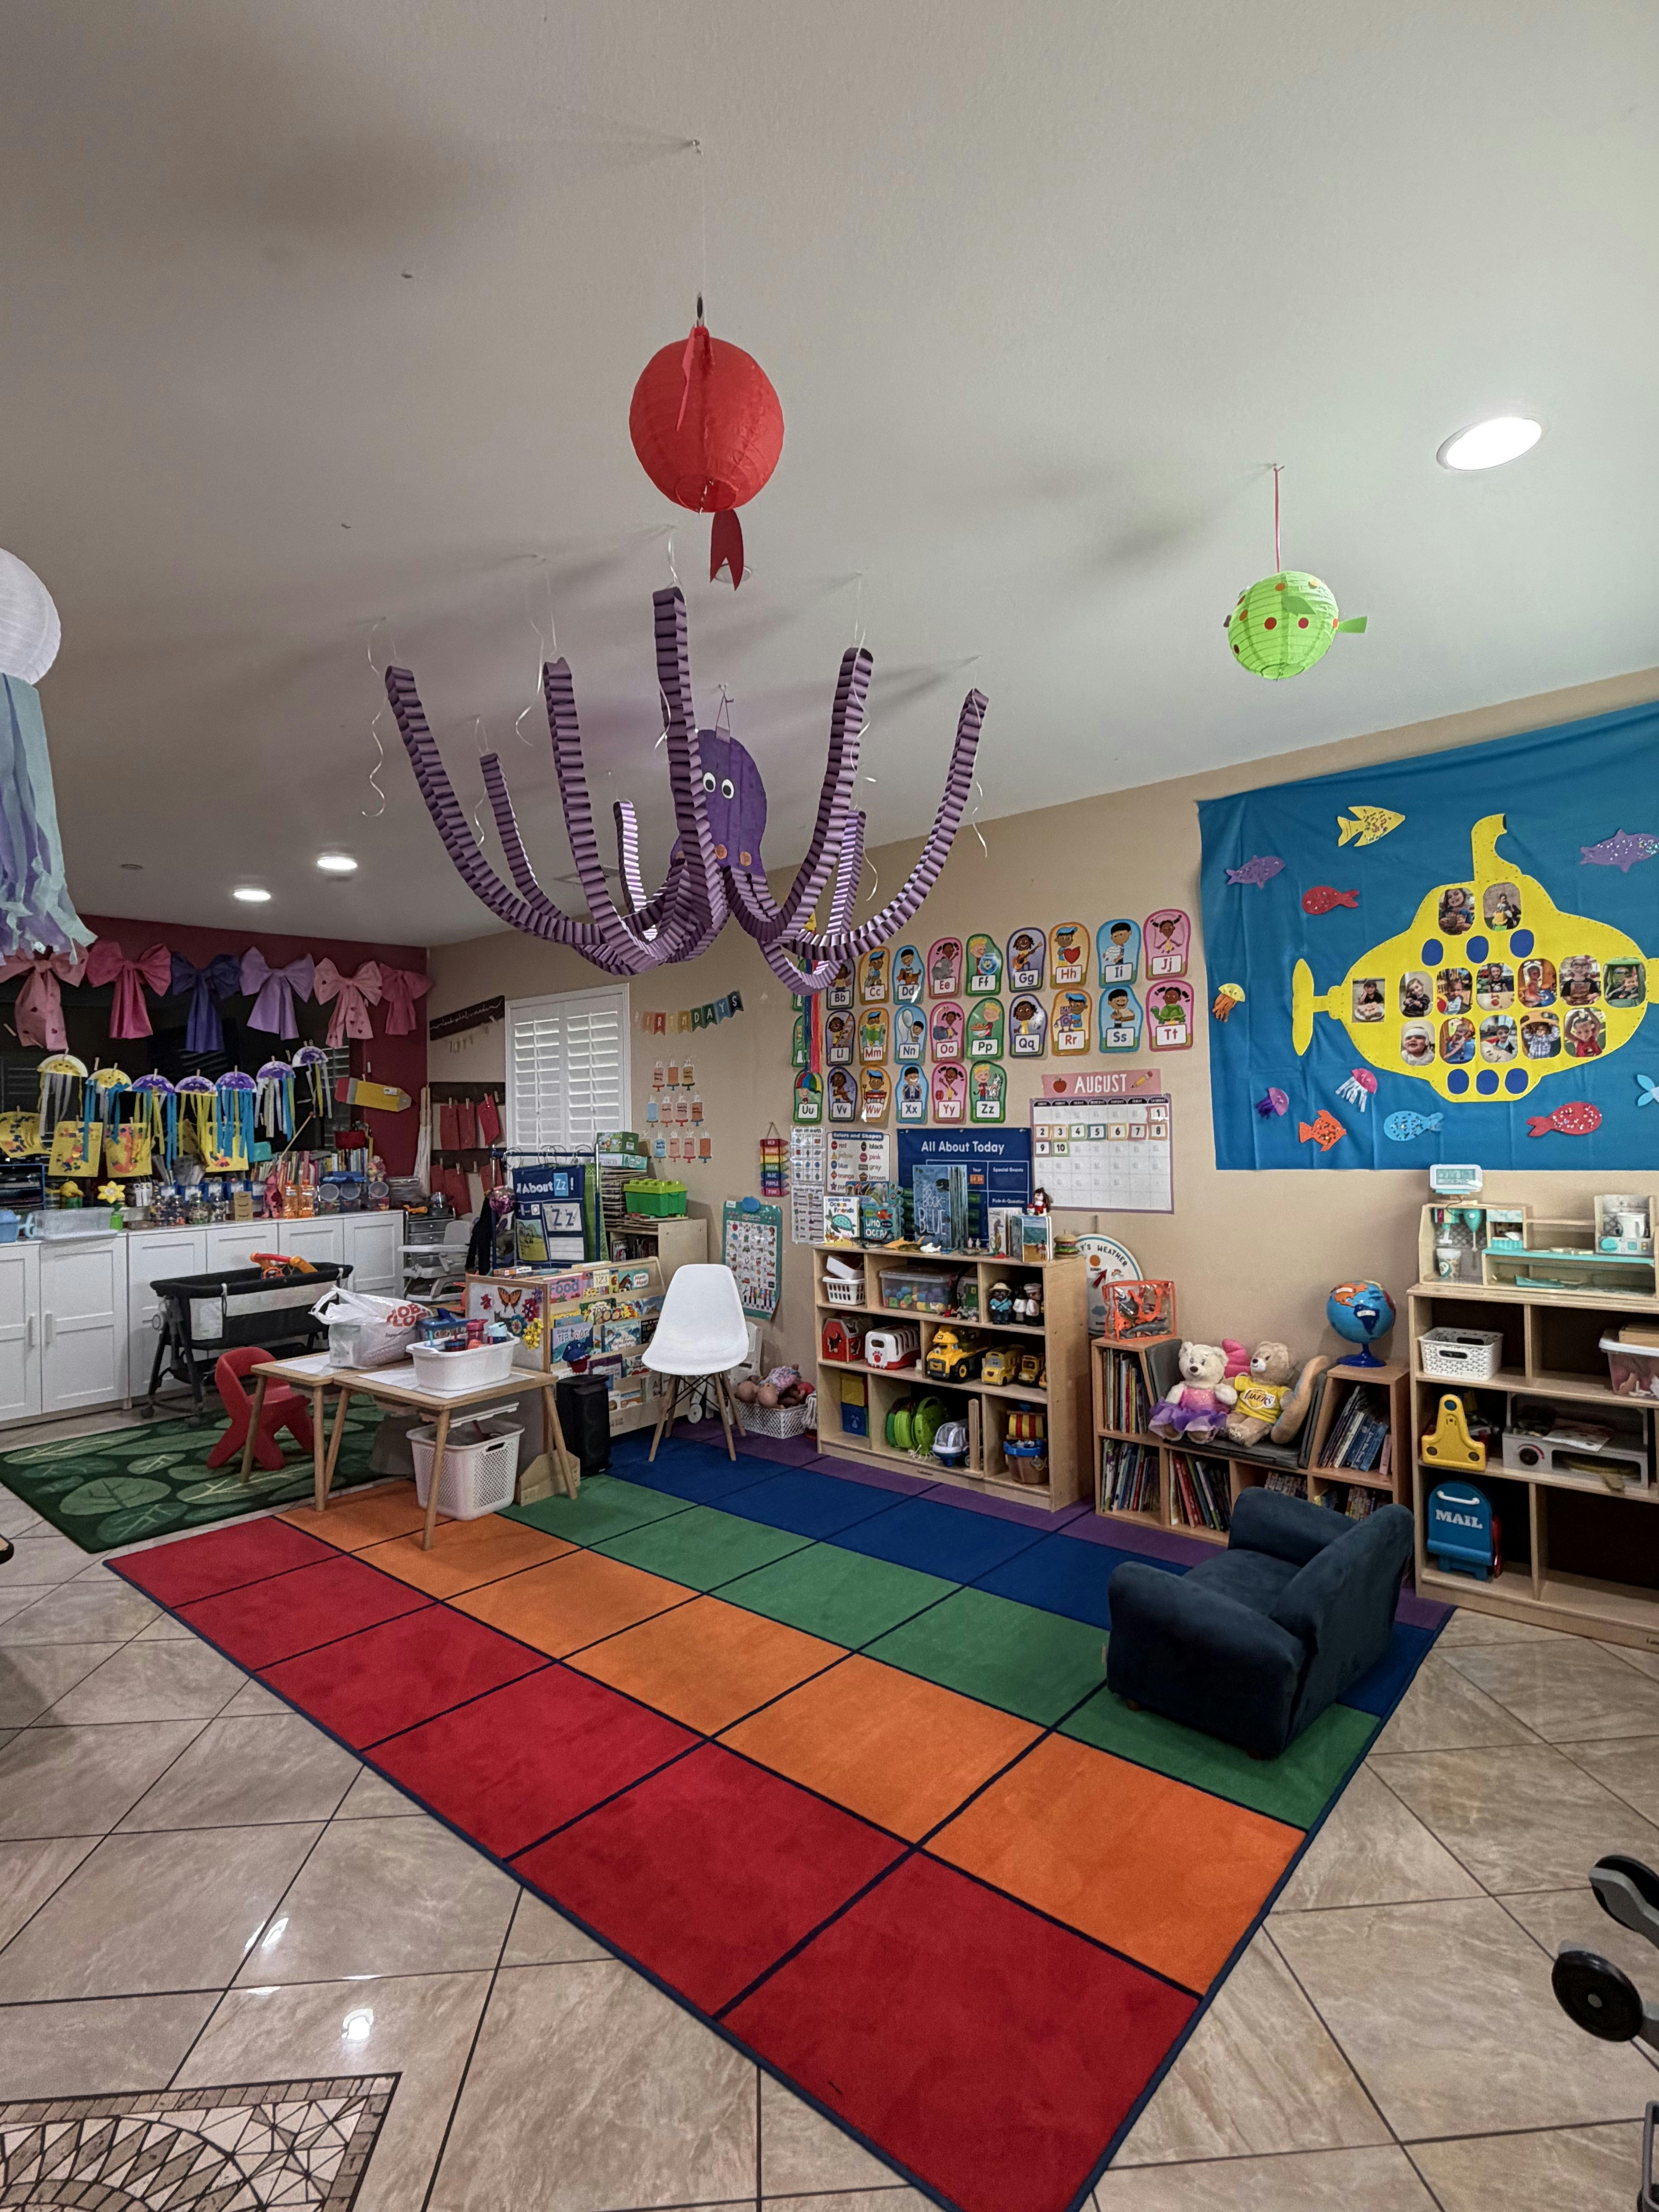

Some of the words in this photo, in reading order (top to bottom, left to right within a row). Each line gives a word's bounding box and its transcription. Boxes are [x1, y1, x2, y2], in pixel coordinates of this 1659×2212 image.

[1160, 959, 1173, 972] Jj
[1060, 969, 1077, 980] Hh
[1114, 967, 1123, 978] Ii
[978, 977, 989, 987] Ff
[1018, 973, 1034, 986] Gg
[902, 986, 914, 995] Dd
[939, 981, 950, 990] Ee
[835, 993, 845, 1002] Bb
[869, 988, 881, 996] Cc
[1113, 1032, 1127, 1042] Ss
[1164, 1028, 1179, 1040] Tt
[1018, 1038, 1036, 1050] Qq
[1065, 1035, 1077, 1046] Rr
[903, 1047, 916, 1056] Nn
[940, 1044, 954, 1054] Oo
[978, 1042, 993, 1053] Pp
[865, 1049, 881, 1058] Mm
[1074, 1074, 1127, 1094] AUGUST
[802, 1106, 814, 1115] Uu
[836, 1105, 847, 1114] Vv
[866, 1104, 880, 1115] Ww
[905, 1105, 918, 1114] Xx
[944, 1104, 955, 1116] Yy
[982, 1104, 994, 1114] Zz
[1156, 1109, 1161, 1117] 1
[1156, 1126, 1161, 1134] 8
[921, 1141, 936, 1152] All
[939, 1141, 970, 1152] About
[972, 1141, 1005, 1155] Today
[522, 1181, 553, 1194] About
[555, 1178, 567, 1191] Zz
[866, 1219, 881, 1228] WHO
[918, 1207, 947, 1235] BLUE
[1097, 1245, 1128, 1267] WEATHER
[550, 1279, 580, 1294] Food
[1435, 1509, 1483, 1529] MAIL
